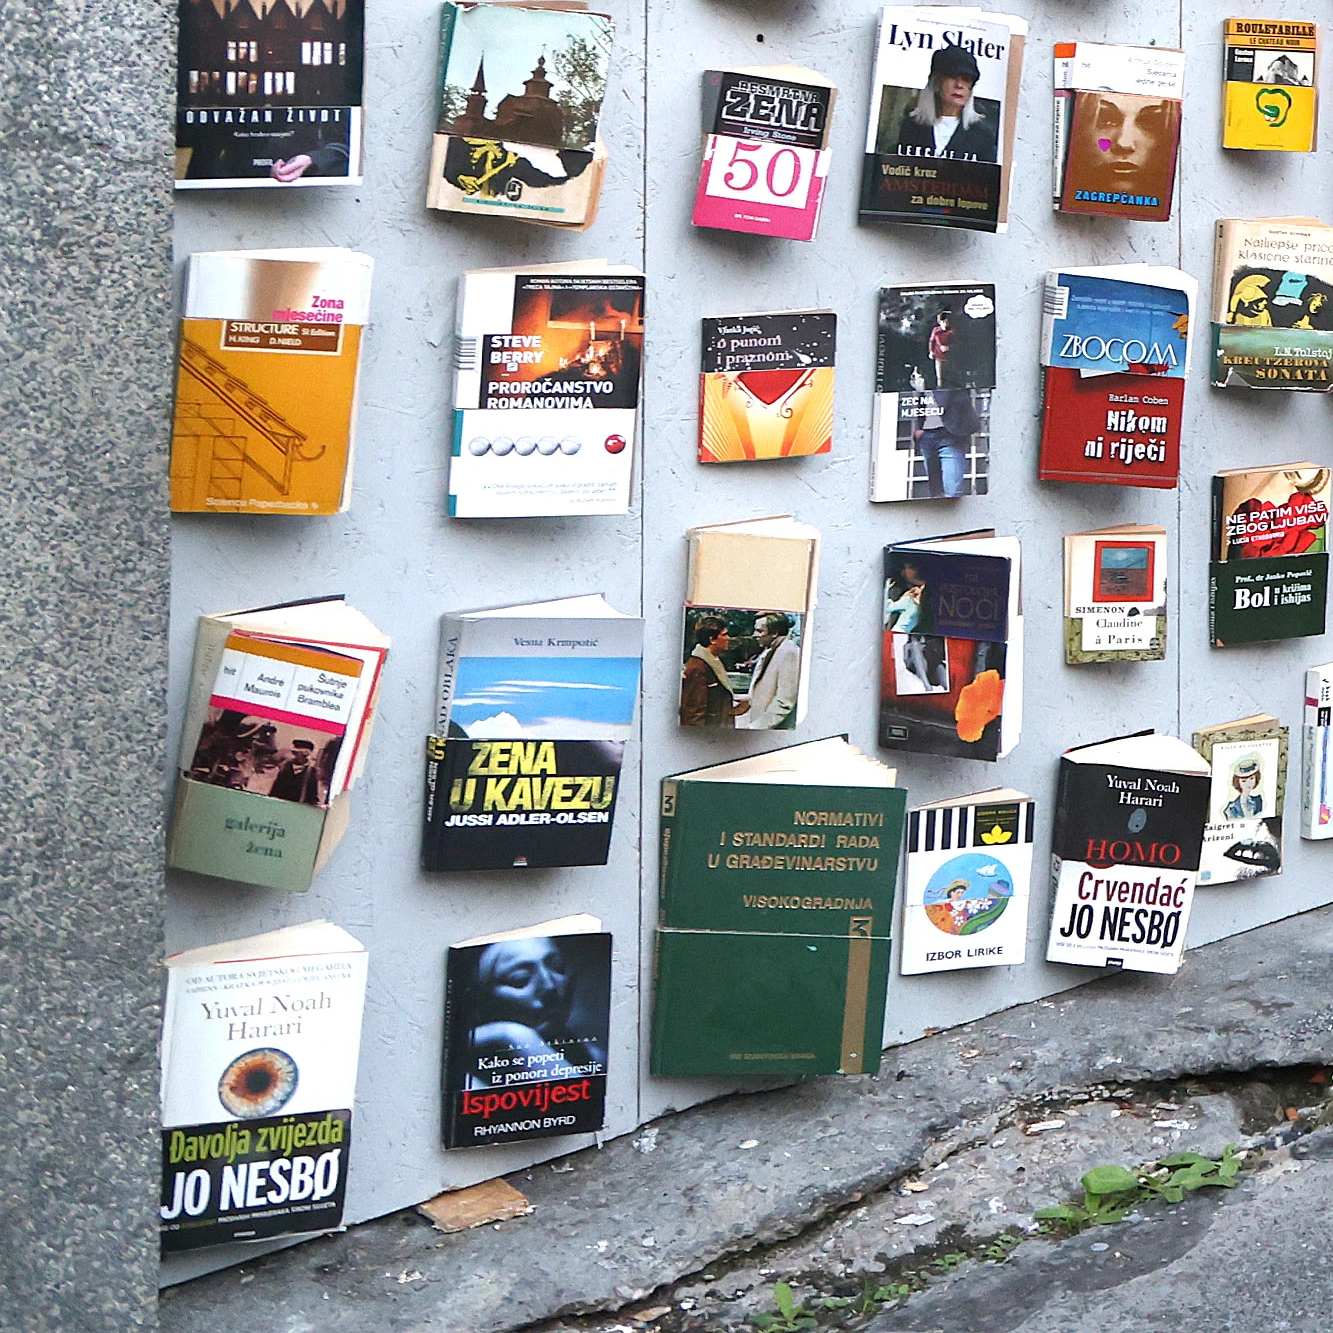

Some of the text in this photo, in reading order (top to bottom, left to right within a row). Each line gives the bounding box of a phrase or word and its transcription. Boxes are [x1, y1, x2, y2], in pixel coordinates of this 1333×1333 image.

[1235, 22, 1314, 37] ROULETABILLE
[888, 23, 1005, 60] Lyn Slater
[738, 81, 821, 104] BESMRTNA
[185, 107, 341, 124] ODVAŽAN ŽIVOT
[721, 86, 826, 133] ŽENA
[723, 140, 801, 198] 50
[881, 164, 937, 179] Vodič kroz
[1074, 189, 1160, 207] ZAGREPČANKA
[311, 295, 345, 310] Zona
[272, 308, 344, 323] mjesečine
[229, 321, 300, 336] STRUCTURE
[490, 335, 543, 348] STEVE
[1058, 333, 1179, 366] ZBOGOM
[489, 350, 545, 365] BERRY
[1222, 355, 1329, 368] KREUTZEROVA
[1254, 368, 1328, 382] SONATA
[487, 377, 614, 396] PROROČANSTVO
[486, 395, 594, 409] ROMANOVIMA
[900, 396, 935, 407] ZEC NA
[901, 407, 944, 418] MJESECU
[1106, 409, 1167, 435] Nikom
[1084, 436, 1167, 465] ni riječi
[1225, 499, 1326, 526] NE PATIM VIŠE
[1225, 510, 1329, 537] ZBOG LJUBAVI
[1233, 586, 1271, 610] Bol
[1281, 582, 1312, 594] križima
[1280, 592, 1312, 605] ishijas
[1075, 606, 1126, 615] SIMENON
[1095, 617, 1143, 630] Claudine
[513, 636, 600, 650] Vesna Krmpotić
[1095, 633, 1144, 646] à Paris
[448, 775, 616, 812] U KAVEZU
[1106, 774, 1180, 794] Yuval Noah
[1118, 792, 1164, 808] Harari
[444, 811, 610, 827] JUSSI ADLER-OLSEN
[793, 810, 885, 828] NORMATIVI
[719, 831, 881, 850] I STANDARDI RADA
[1085, 838, 1182, 865] HOMO
[707, 853, 879, 872] U GRAĐEVINARSTVU
[1078, 870, 1188, 909] Crvendać
[742, 894, 873, 911] VISOKOGRADNJA
[1060, 902, 1183, 950] JO NESBØ
[925, 946, 1004, 962] IZBOR LIRIKE
[200, 991, 332, 1022] Yuval Noah
[227, 1016, 303, 1042] Harari
[477, 1049, 565, 1071] Kako se popeti
[491, 1061, 603, 1086] iz ponora depresije
[461, 1078, 592, 1120] Ispovijest
[473, 1115, 577, 1138] RHYANNON BYRD
[169, 1113, 344, 1165] Đavolja zvijezda
[160, 1168, 211, 1221] JO
[218, 1148, 343, 1213] NESBØ
